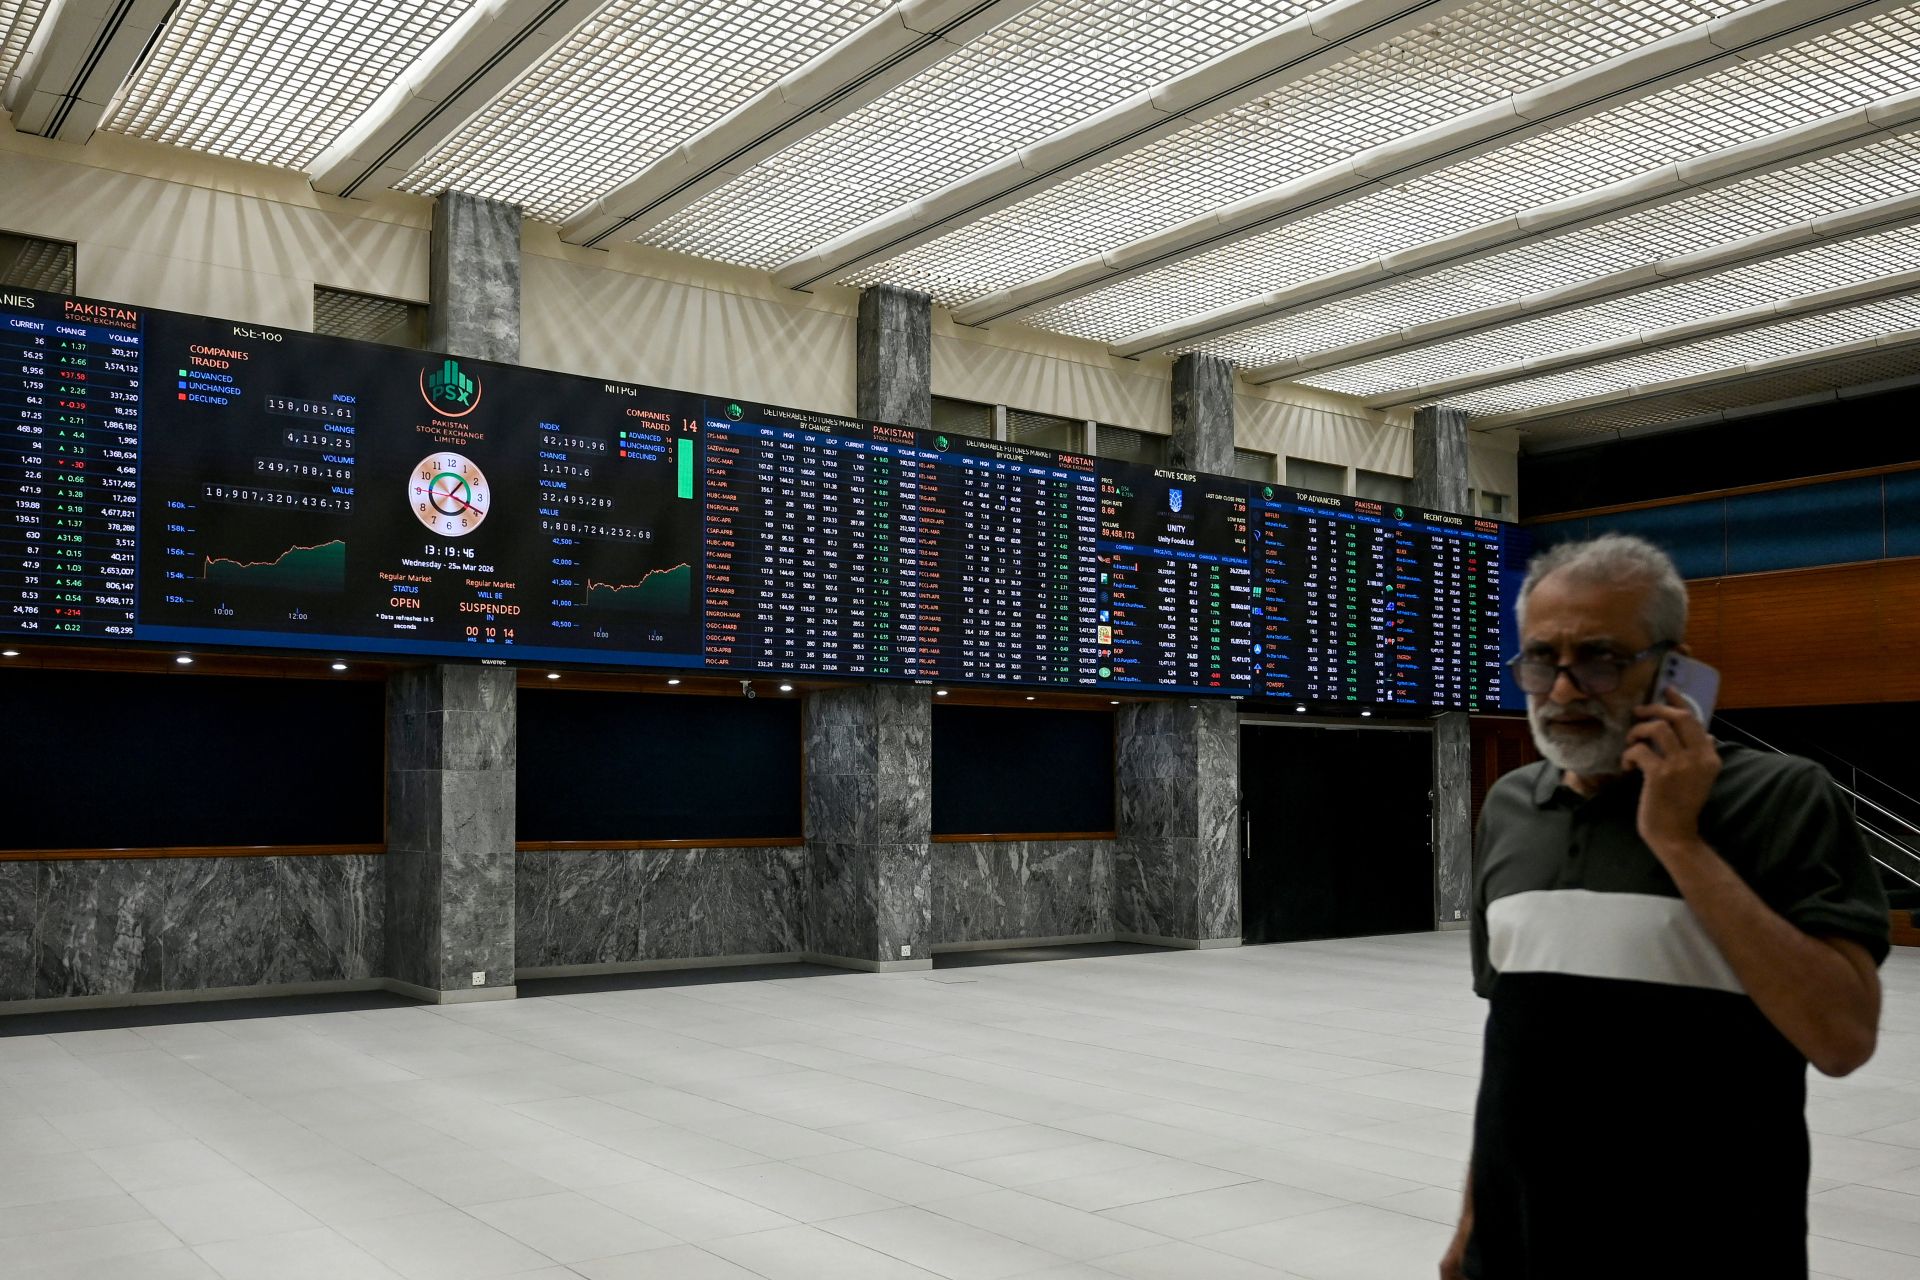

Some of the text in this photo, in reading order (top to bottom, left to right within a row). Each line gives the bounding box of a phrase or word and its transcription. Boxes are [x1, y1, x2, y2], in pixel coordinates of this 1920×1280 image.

[65, 302, 137, 321] PAKISTAN
[65, 313, 137, 329] STOCK EXCHANGE
[10, 319, 139, 344] CURRENT CHANGE VOLUME
[233, 327, 282, 343] KSE-100
[23, 351, 43, 359] 56.25
[112, 348, 138, 358] 303,217
[190, 344, 249, 361] COMPANIES
[190, 356, 229, 369] TRADED
[23, 366, 43, 375] 8,956
[189, 371, 233, 383] ADVANCED
[23, 381, 43, 389] 1,759
[190, 382, 241, 395] UNCHANGED
[189, 394, 228, 405] DECLINED
[333, 394, 356, 404] INDEX
[432, 385, 470, 407] PSX
[269, 399, 352, 418] 158,085.61
[22, 411, 42, 419] 87.25
[627, 409, 671, 421] COMPANIES
[324, 424, 356, 435] CHANGE
[432, 420, 469, 430] PAKISTAN
[539, 422, 560, 431] INDEX
[641, 419, 698, 432] TRADED 14
[707, 421, 731, 430] COMPANY
[808, 423, 831, 432] CHANGE
[416, 426, 484, 440] STOCK EXCHANGE
[629, 432, 661, 442] ADVANCED
[873, 426, 914, 439] PAKISTAN
[288, 433, 351, 449] 4,119.25
[434, 435, 467, 445] LIMITED
[543, 435, 605, 451] 42,190.96
[627, 442, 665, 452] UNCHANGED
[103, 450, 137, 459] 1,368,634
[539, 452, 567, 461] CHANGE
[628, 452, 657, 461] DECLINED
[1004, 453, 1024, 462] VOLUME
[21, 456, 41, 464] 1,470
[323, 455, 355, 465] VOLUME
[448, 459, 456, 467] 12
[1058, 454, 1094, 467] PAKISTAN
[258, 461, 351, 479] 249,788,168
[433, 462, 441, 470] 11
[464, 465, 467, 473] 1
[543, 464, 590, 477] 1,170.6
[422, 472, 431, 480] 10
[1154, 469, 1197, 482] ACTIVE SCRIPS
[474, 478, 478, 486] 2
[539, 480, 567, 489] VOLUME
[20, 486, 41, 494] 471.9
[332, 486, 355, 495] VALUE
[1101, 484, 1115, 494] 8.53
[206, 488, 350, 510] 18,907,320,436.73
[478, 494, 483, 502] 3
[542, 493, 612, 508] 32,495,289
[1296, 493, 1341, 506] TOP ADVANCERS
[167, 501, 186, 509] 160k
[1354, 501, 1382, 511] PAKISTAN
[539, 508, 559, 516] VALUE
[432, 516, 437, 524] 7
[462, 519, 467, 527] 5
[1424, 513, 1463, 525] RECENT QUOTES
[167, 525, 186, 533] 158k
[447, 522, 452, 530] 6
[1167, 524, 1185, 533] UNITY
[1474, 520, 1498, 529] PAKISTAN
[542, 521, 651, 539] 8,808,724,252.68
[552, 538, 573, 546] 42,500
[1158, 536, 1170, 545] Unity
[1171, 537, 1186, 545] Foods
[167, 548, 185, 556] 156k
[402, 559, 442, 570] Wednesday
[552, 558, 572, 567] 42,000
[166, 572, 185, 580] 154k
[380, 572, 432, 583] Regular Market
[466, 579, 516, 589] Regular Market
[552, 579, 572, 587] 41,500
[394, 585, 419, 593] STATUS
[390, 598, 420, 608] OPEN
[552, 600, 572, 608] 41,000
[13, 606, 38, 614] 24,786
[214, 608, 234, 616] 10:00
[460, 602, 521, 615] SUSPENDED
[105, 626, 133, 634] 469,295
[466, 627, 514, 638] 00 10 14
